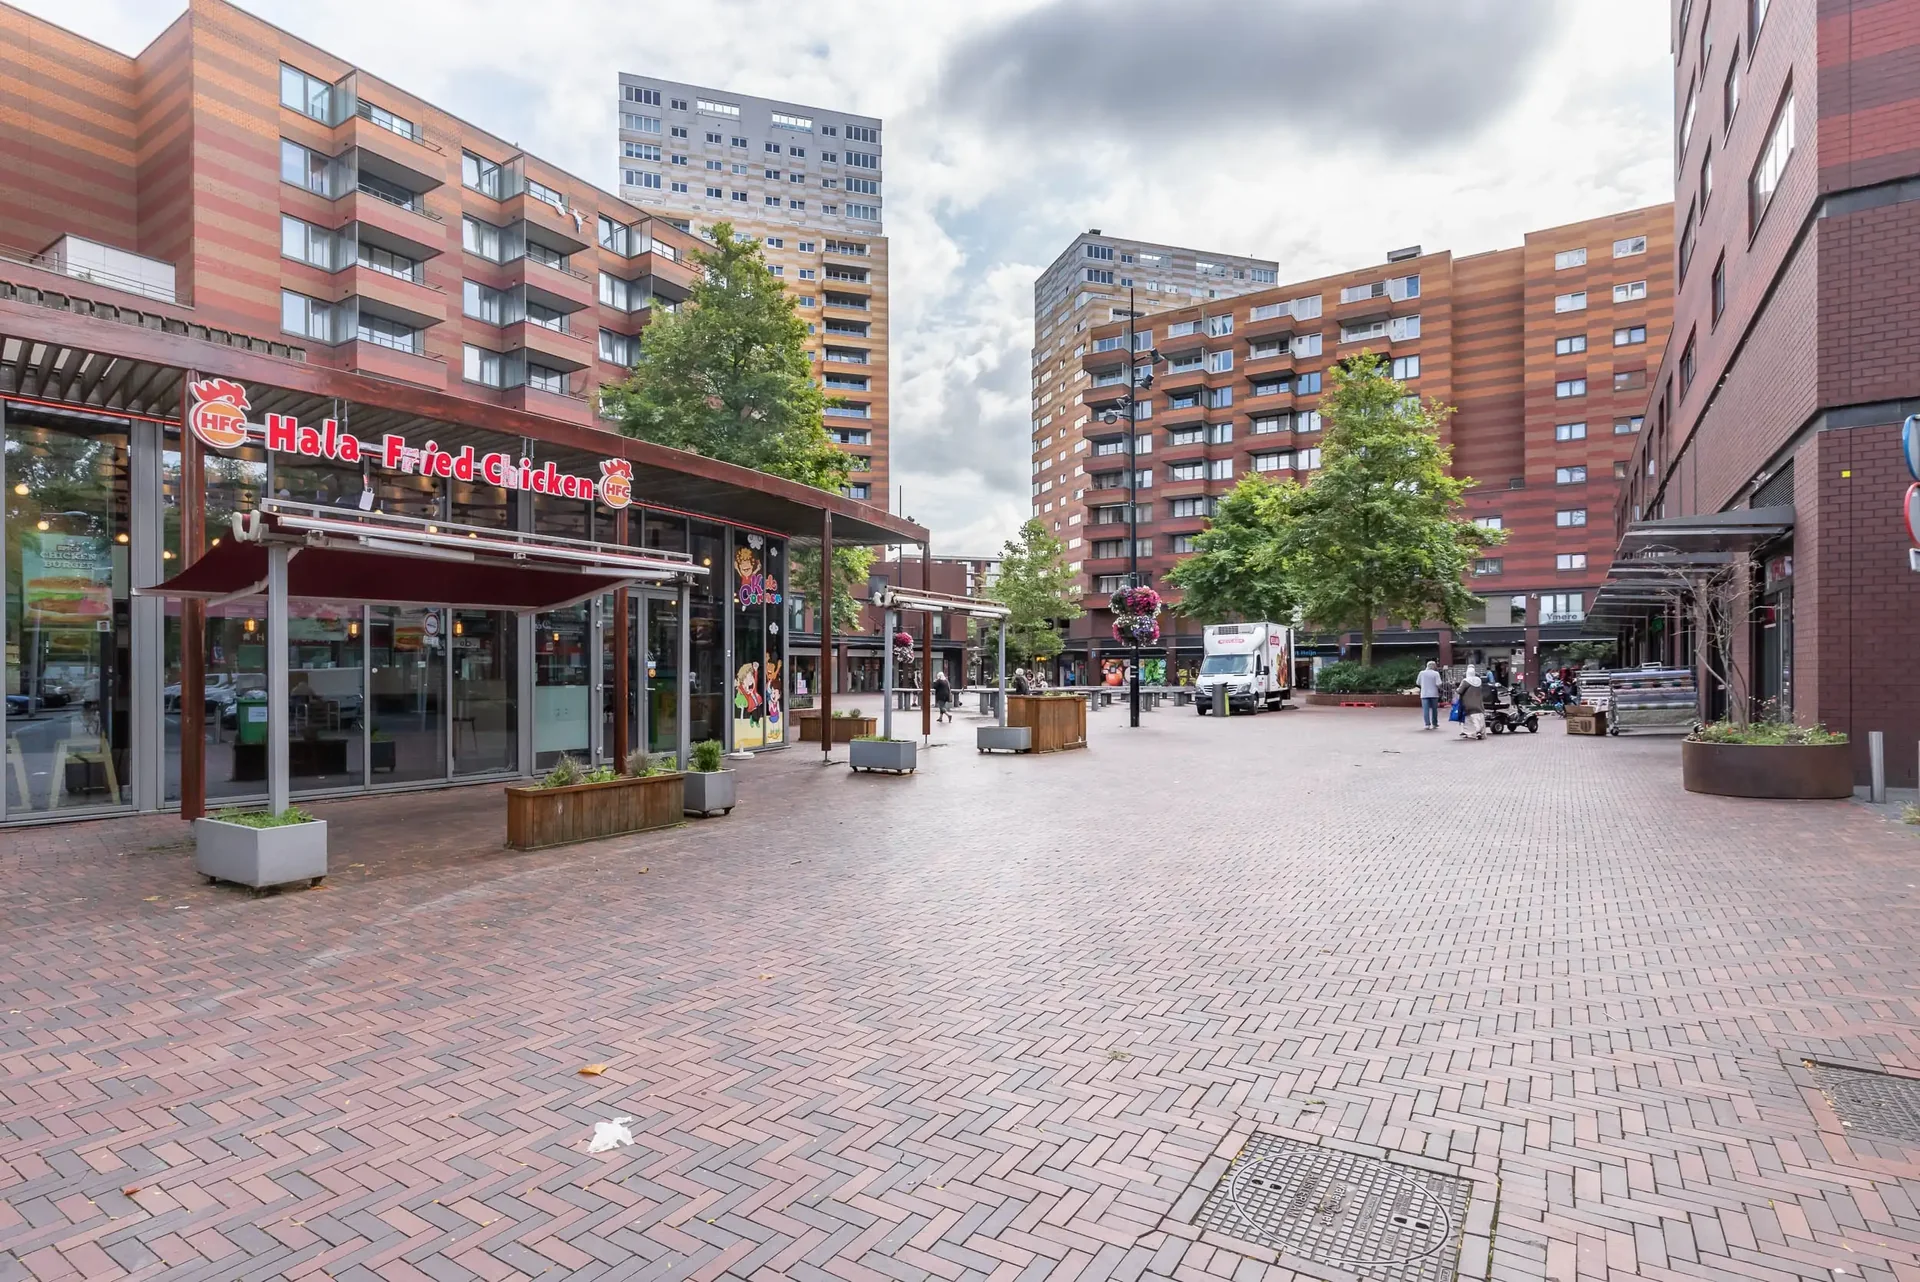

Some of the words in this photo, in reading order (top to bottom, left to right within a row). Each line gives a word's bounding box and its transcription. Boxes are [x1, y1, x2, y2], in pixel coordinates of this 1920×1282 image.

[201, 411, 245, 435] HFC
[265, 412, 363, 464] Hala
[382, 433, 475, 482] Fried
[480, 452, 595, 501] Chicken
[605, 482, 631, 499] HFC
[40, 551, 97, 561] CHICKEN
[44, 560, 95, 569] BURGER
[739, 584, 782, 606] Corner
[1546, 612, 1578, 621] Ymere
[1289, 1173, 1318, 1218] AMSTERDAM
